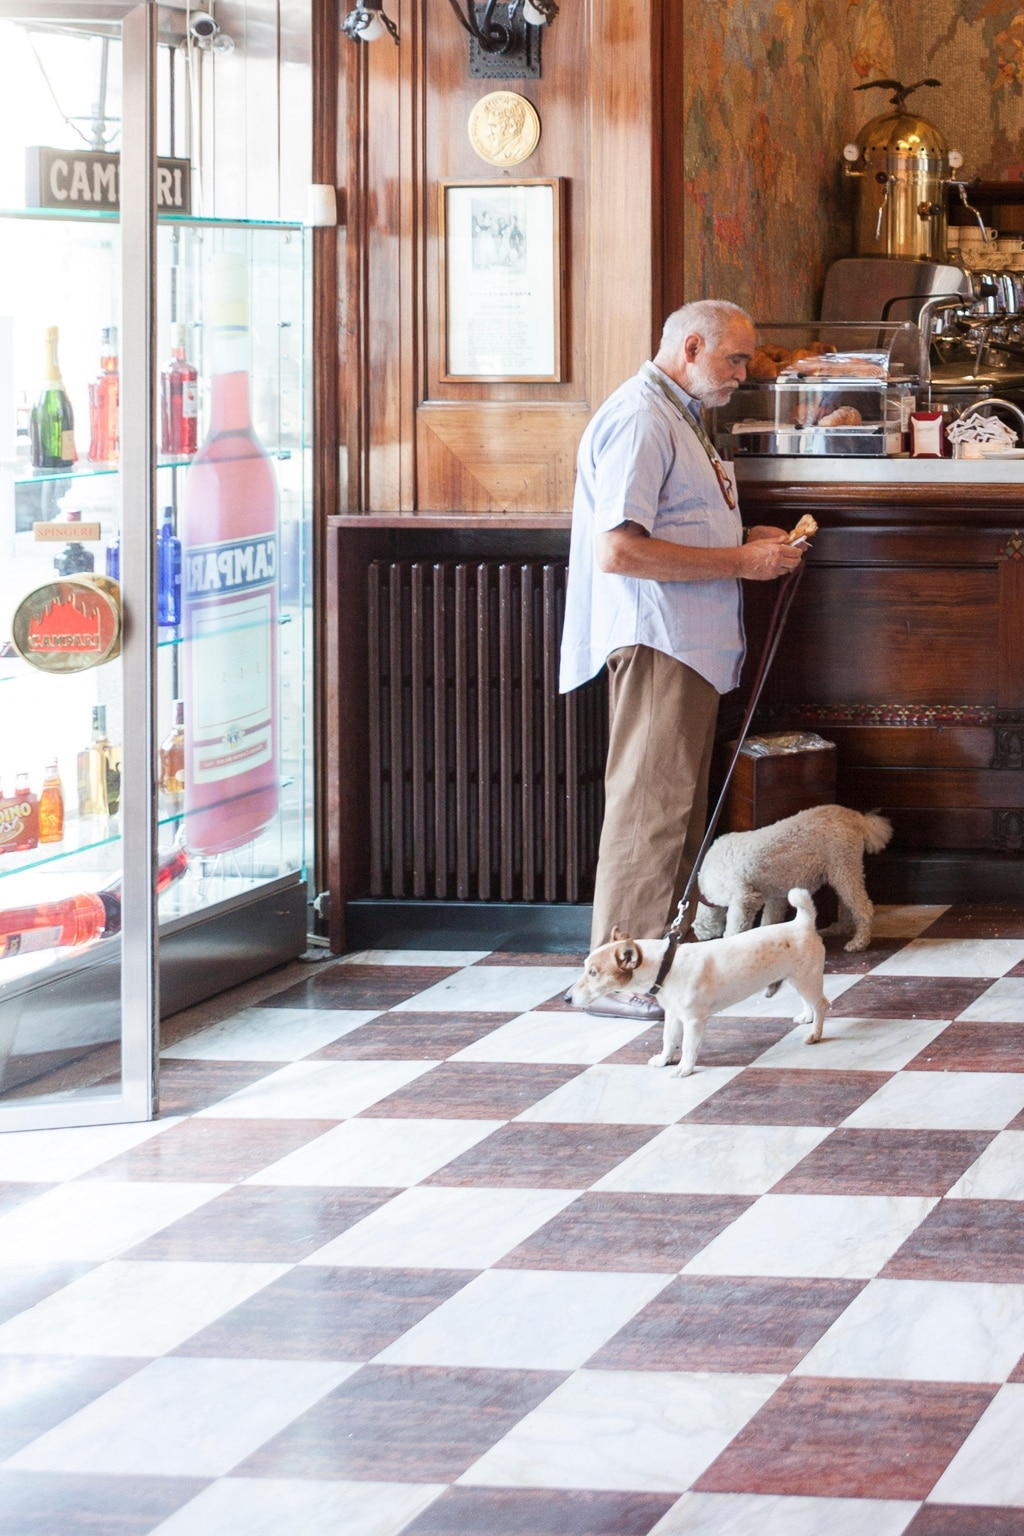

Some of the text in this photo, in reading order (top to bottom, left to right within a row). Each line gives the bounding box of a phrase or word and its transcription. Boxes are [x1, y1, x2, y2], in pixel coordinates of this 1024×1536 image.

[50, 158, 183, 207] CAMRI
[36, 526, 95, 537] SPINGERE
[29, 633, 100, 648] CAMPARI
